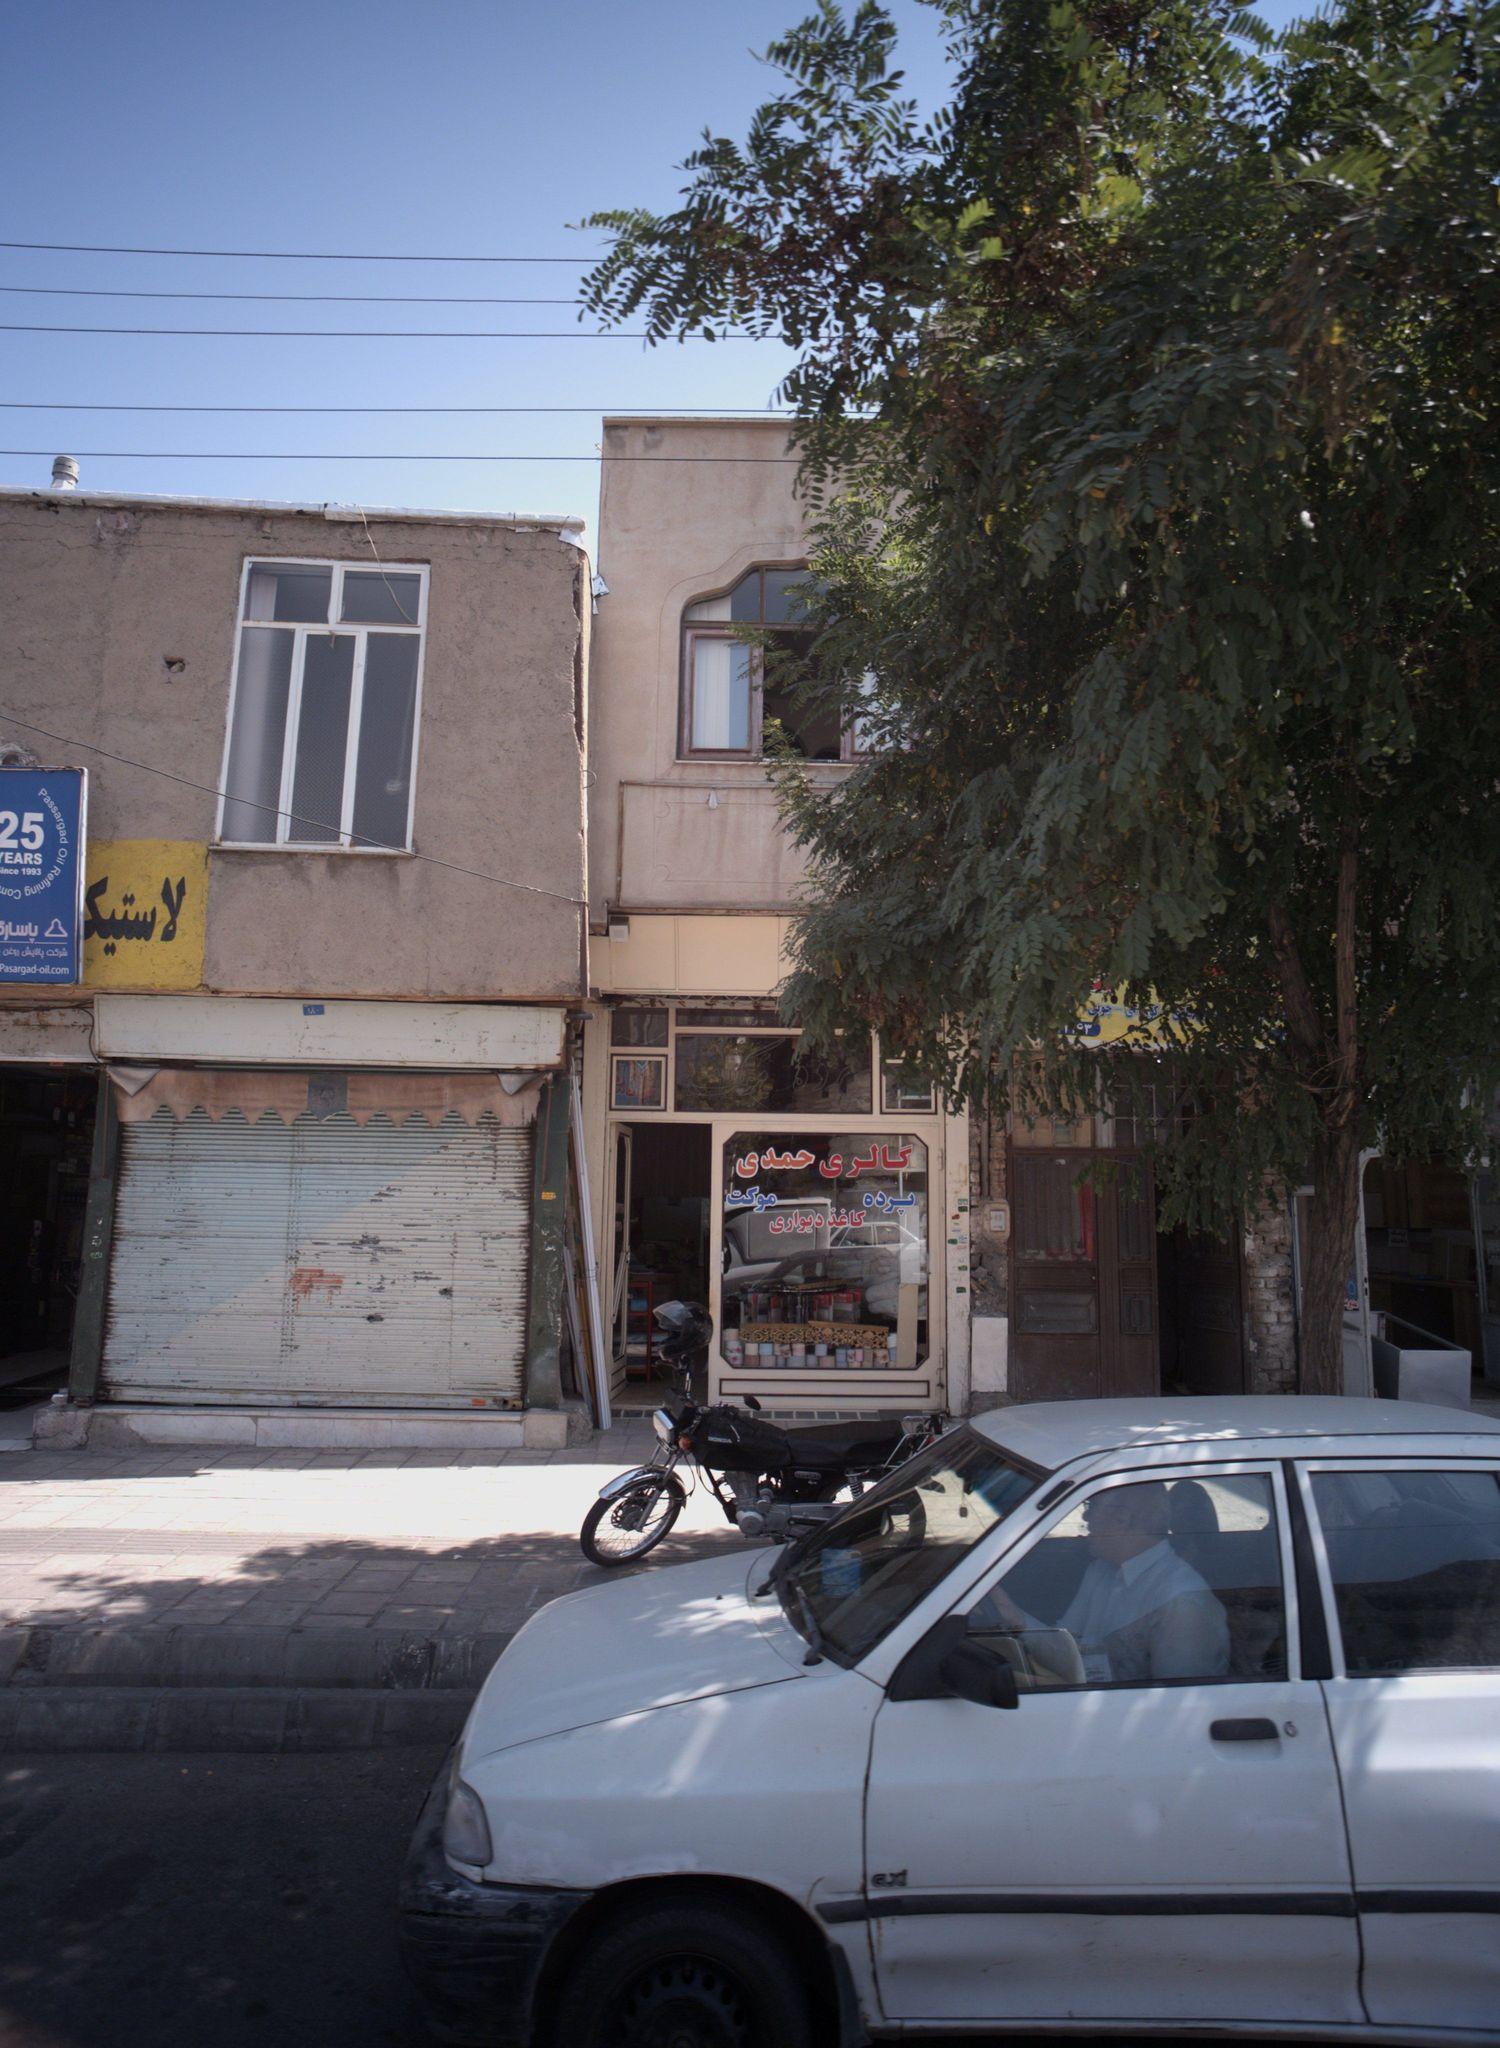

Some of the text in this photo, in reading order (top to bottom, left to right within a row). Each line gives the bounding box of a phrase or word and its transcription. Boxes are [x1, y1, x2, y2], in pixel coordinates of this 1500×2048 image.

[0, 810, 45, 850] 25
[37, 787, 69, 844] Passargad
[20, 867, 42, 876] 1993
[736, 1143, 913, 1179] گالری حمدی
[725, 1186, 916, 1216] پرده موکت
[769, 1208, 866, 1234] کاغذ دیواری
